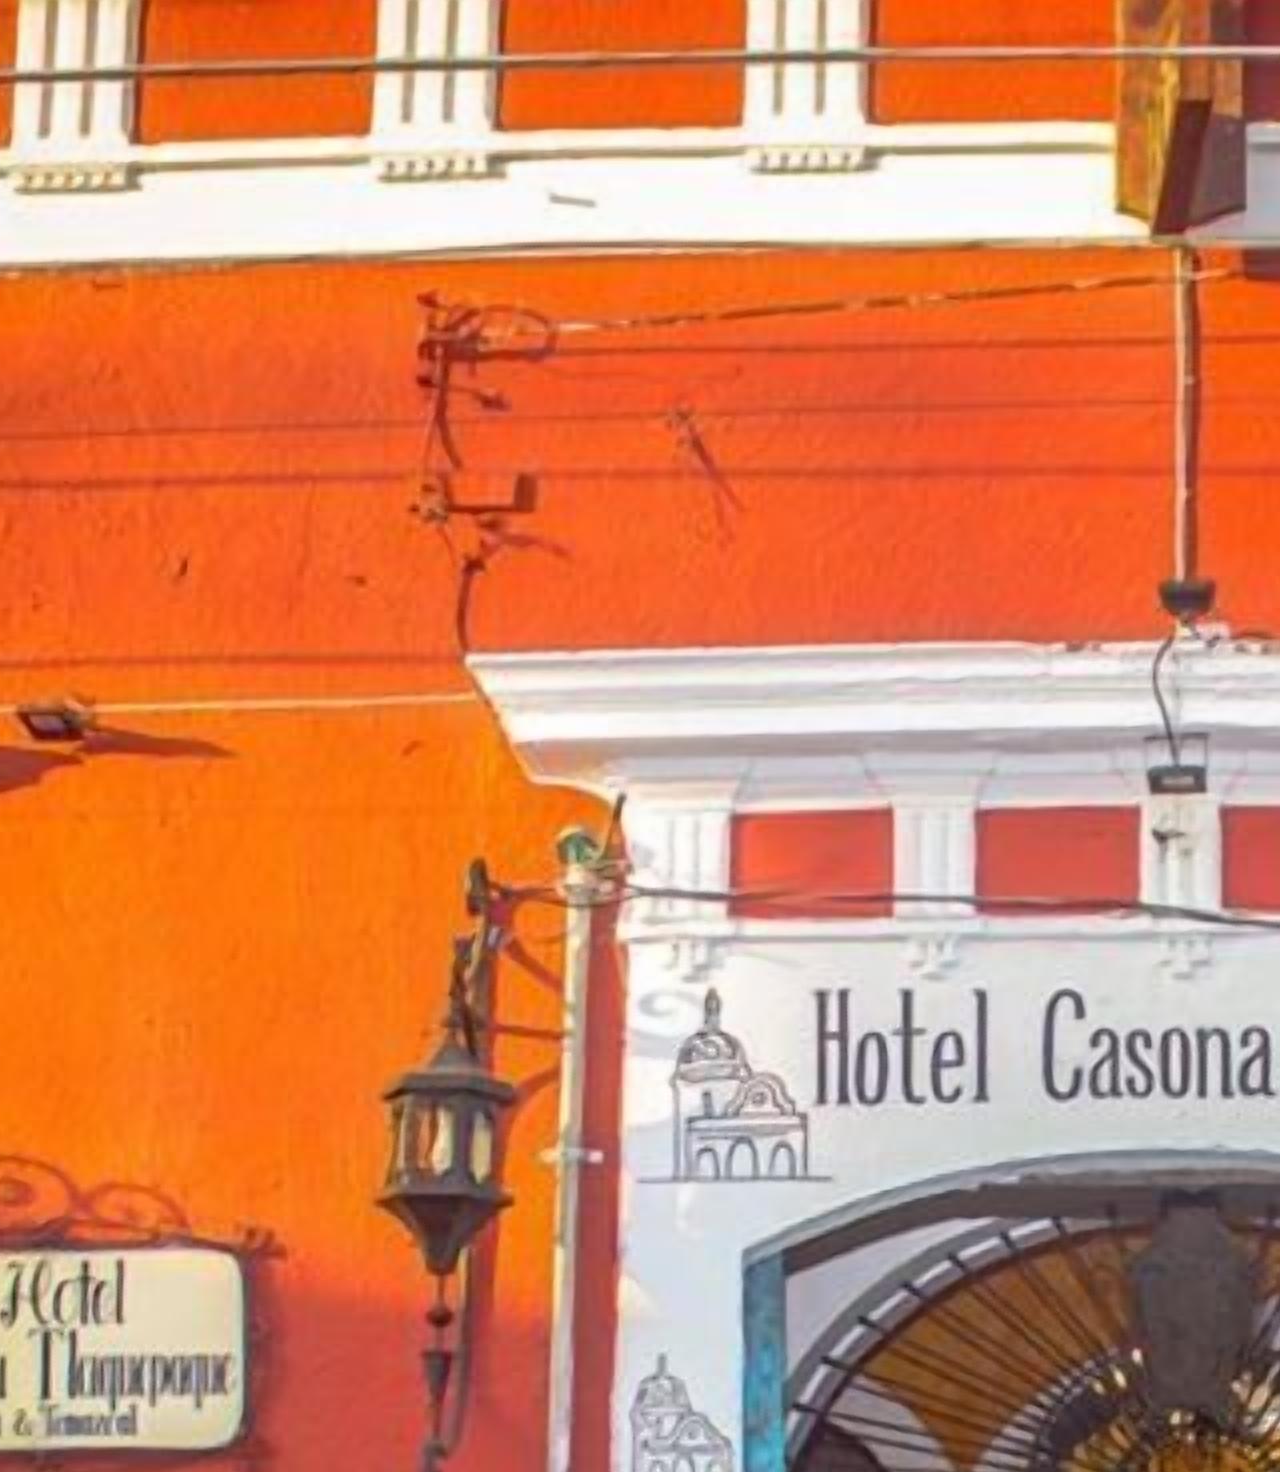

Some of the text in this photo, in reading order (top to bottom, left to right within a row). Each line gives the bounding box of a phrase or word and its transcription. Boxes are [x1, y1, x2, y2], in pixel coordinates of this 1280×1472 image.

[813, 986, 989, 1107] Hotel
[1041, 986, 1275, 1102] Casona
[0, 1258, 126, 1328] Hotel
